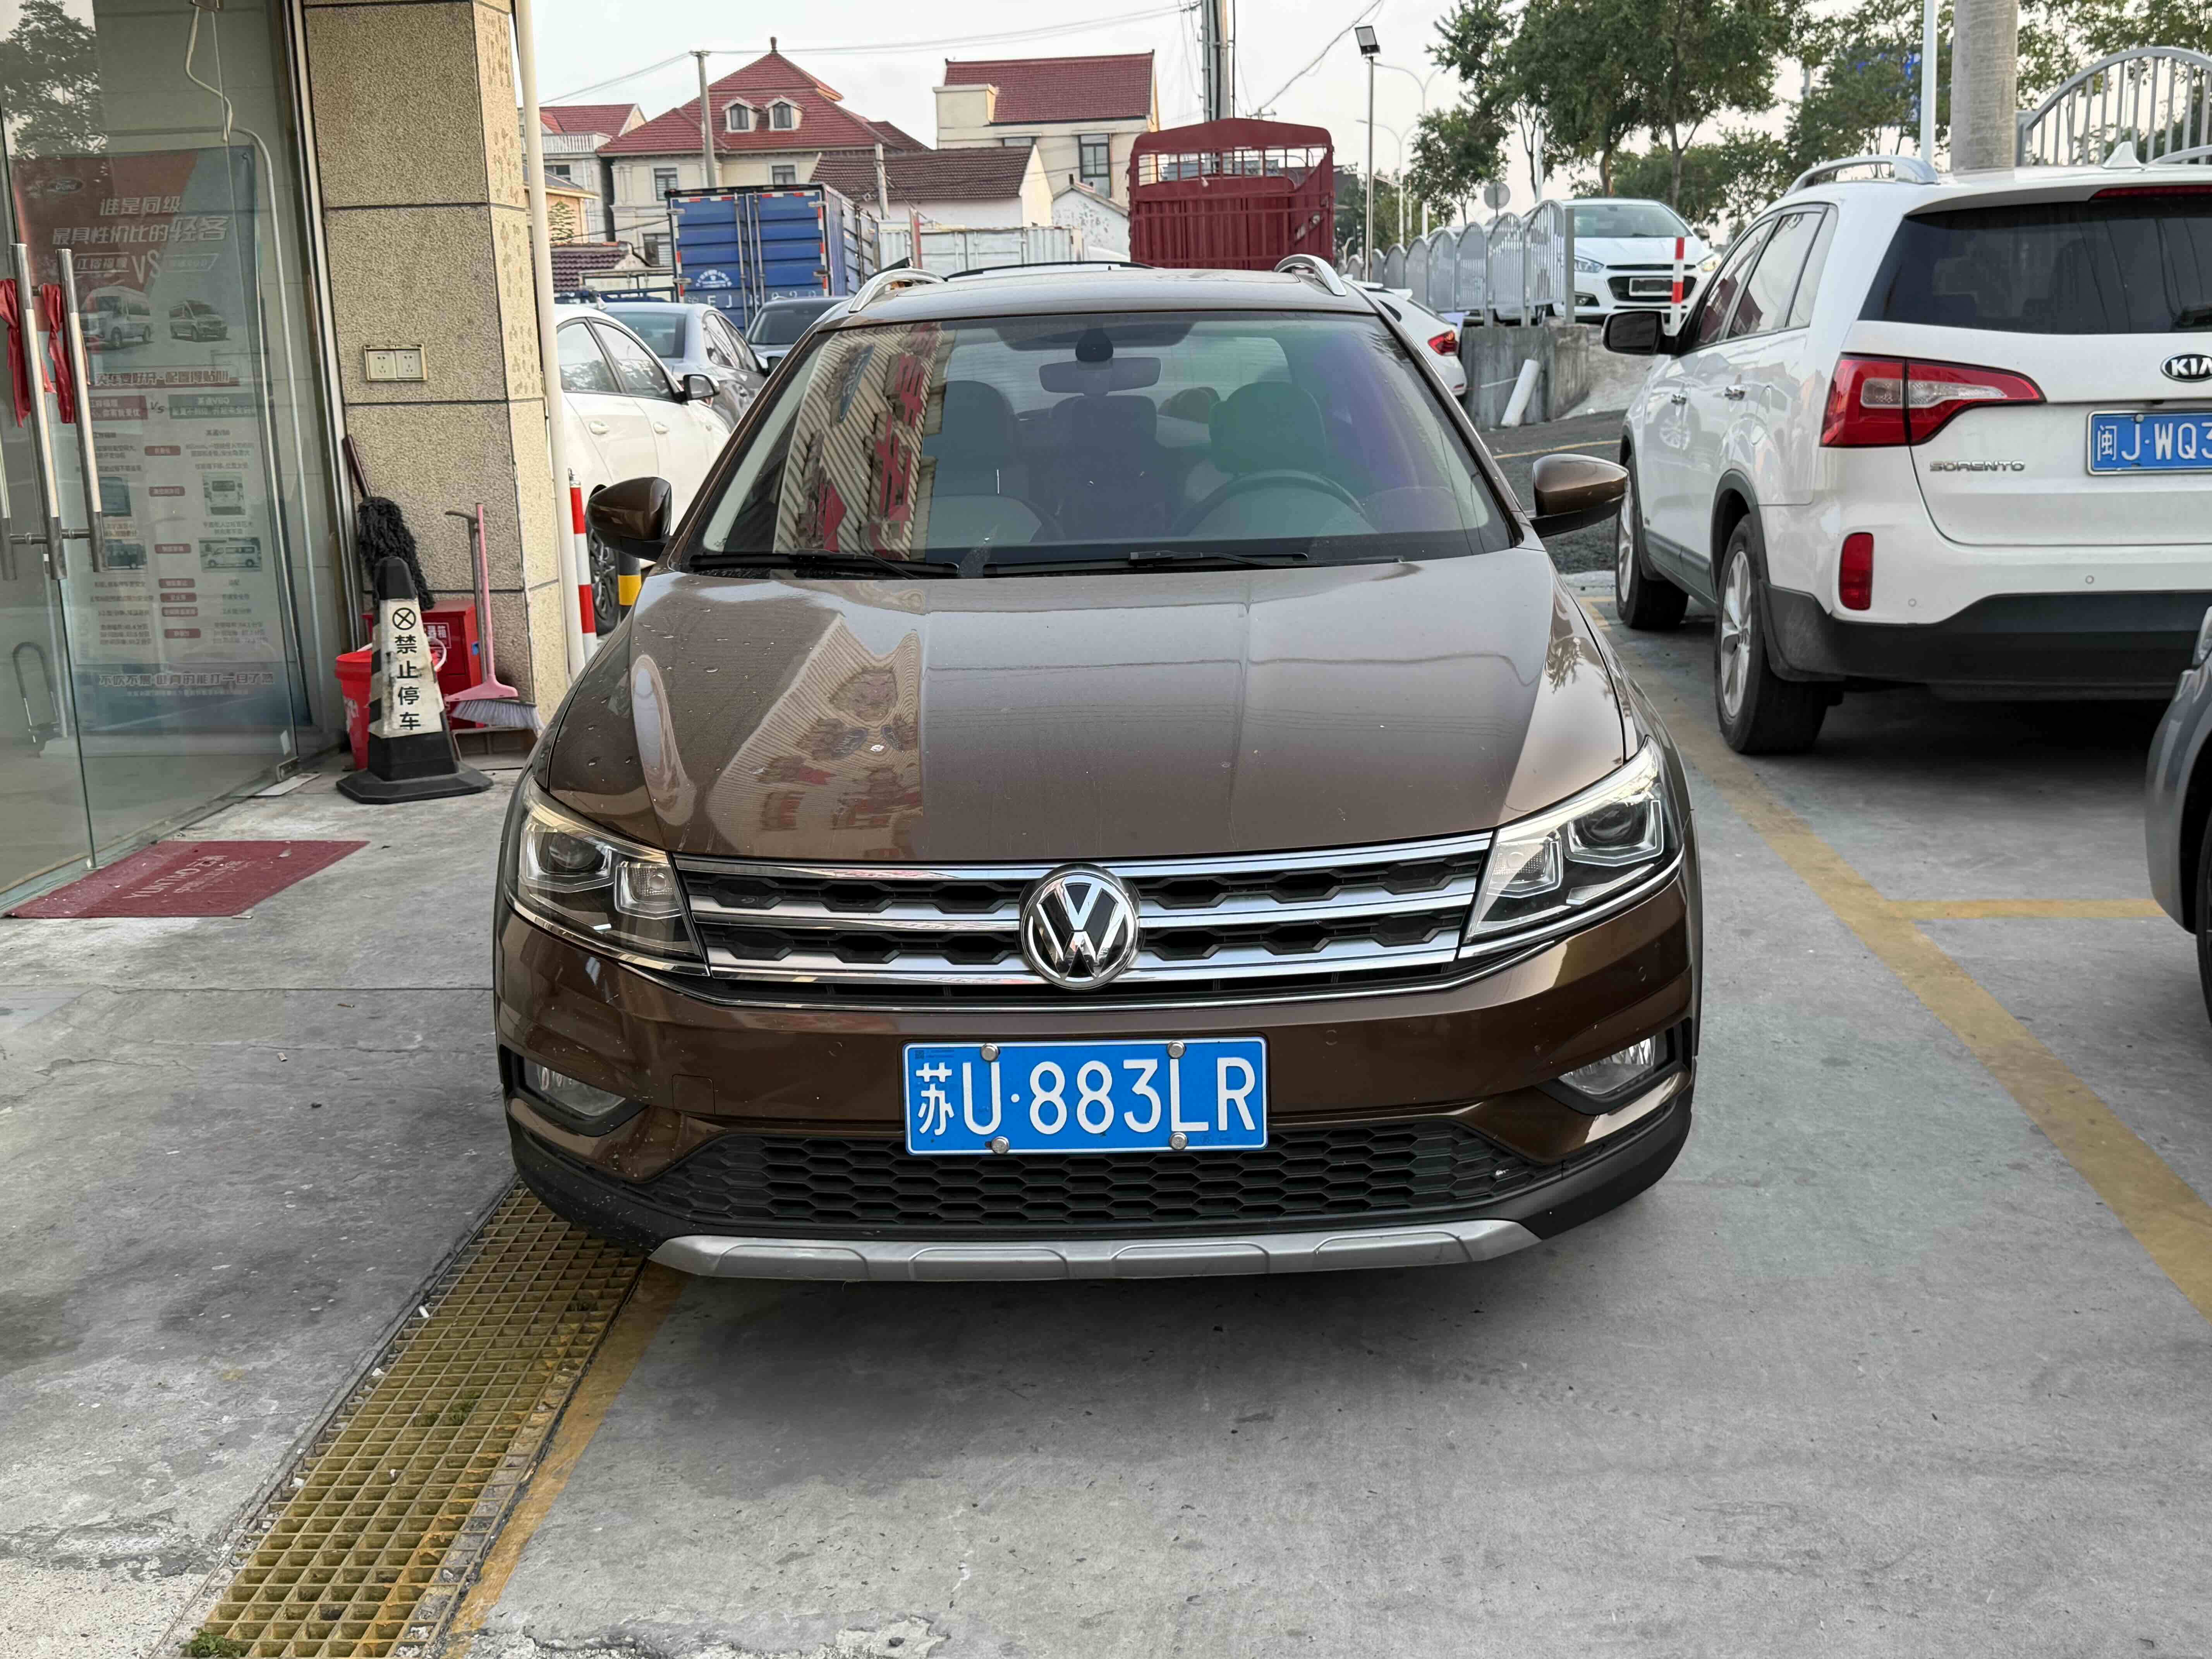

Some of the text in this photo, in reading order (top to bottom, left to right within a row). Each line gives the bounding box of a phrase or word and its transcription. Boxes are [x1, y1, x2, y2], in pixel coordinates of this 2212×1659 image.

[100, 195, 182, 216] 谁是同级
[52, 215, 230, 245] 最具性价比的轻客
[132, 249, 161, 283] VS
[2170, 357, 2212, 376] KIA
[1930, 461, 2025, 472] SORENTO
[395, 634, 421, 731] 禁止停车
[916, 1057, 1255, 1136] 苏U·883LR
